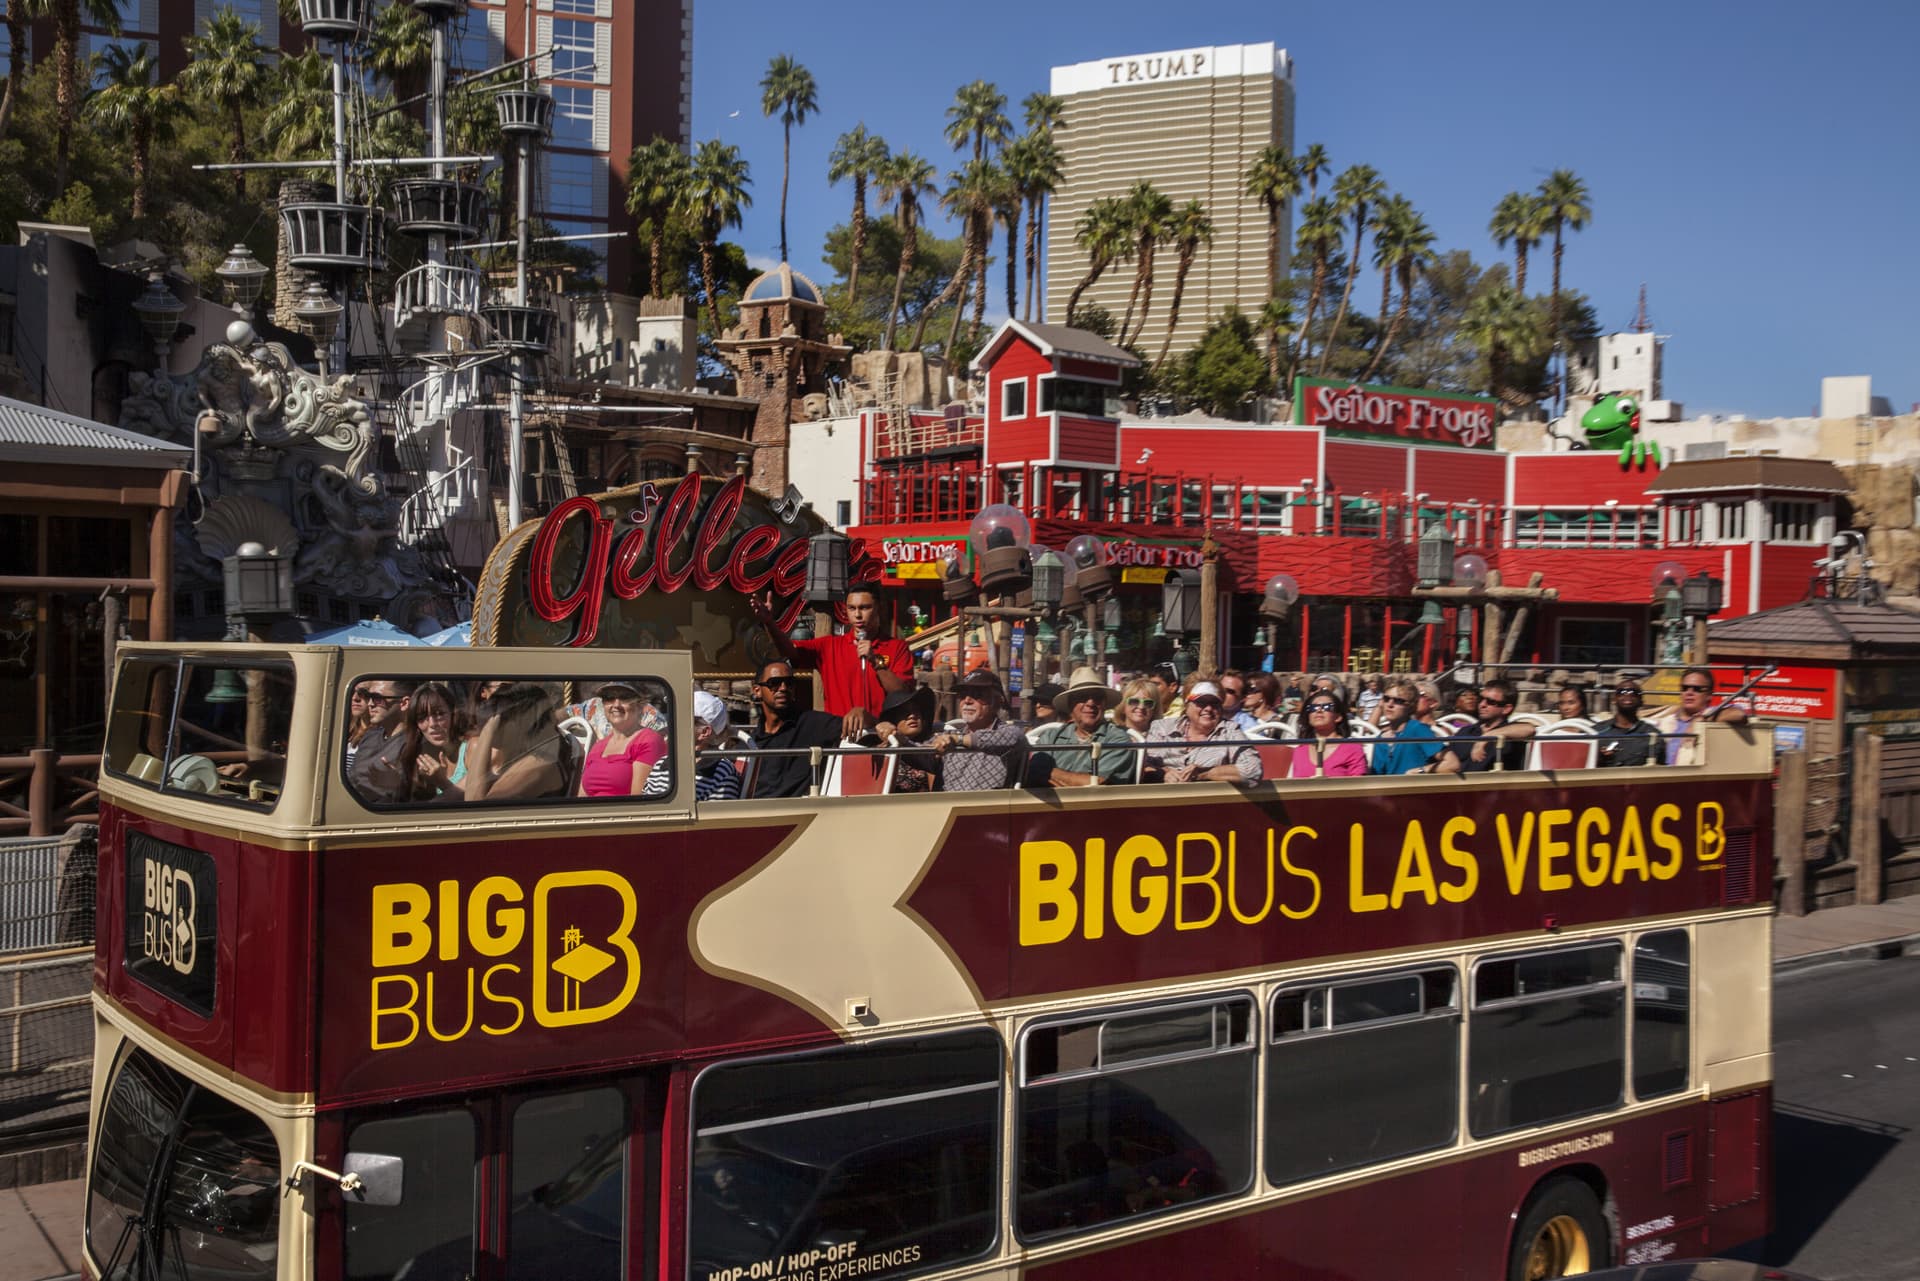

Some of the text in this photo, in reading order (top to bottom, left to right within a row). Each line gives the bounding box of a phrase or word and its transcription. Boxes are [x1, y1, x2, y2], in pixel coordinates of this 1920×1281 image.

[1108, 53, 1206, 83] TRUMP
[1315, 384, 1404, 424] Señor
[1349, 816, 1480, 913] LAS
[1496, 803, 1684, 896] VEGAS
[144, 857, 173, 916] BIG
[144, 912, 172, 967] BUS
[372, 876, 526, 968] BIG
[371, 963, 525, 1051] BUS
[788, 1241, 857, 1272] HOP-OFF
[819, 1245, 922, 1281] EXPERIENCES
